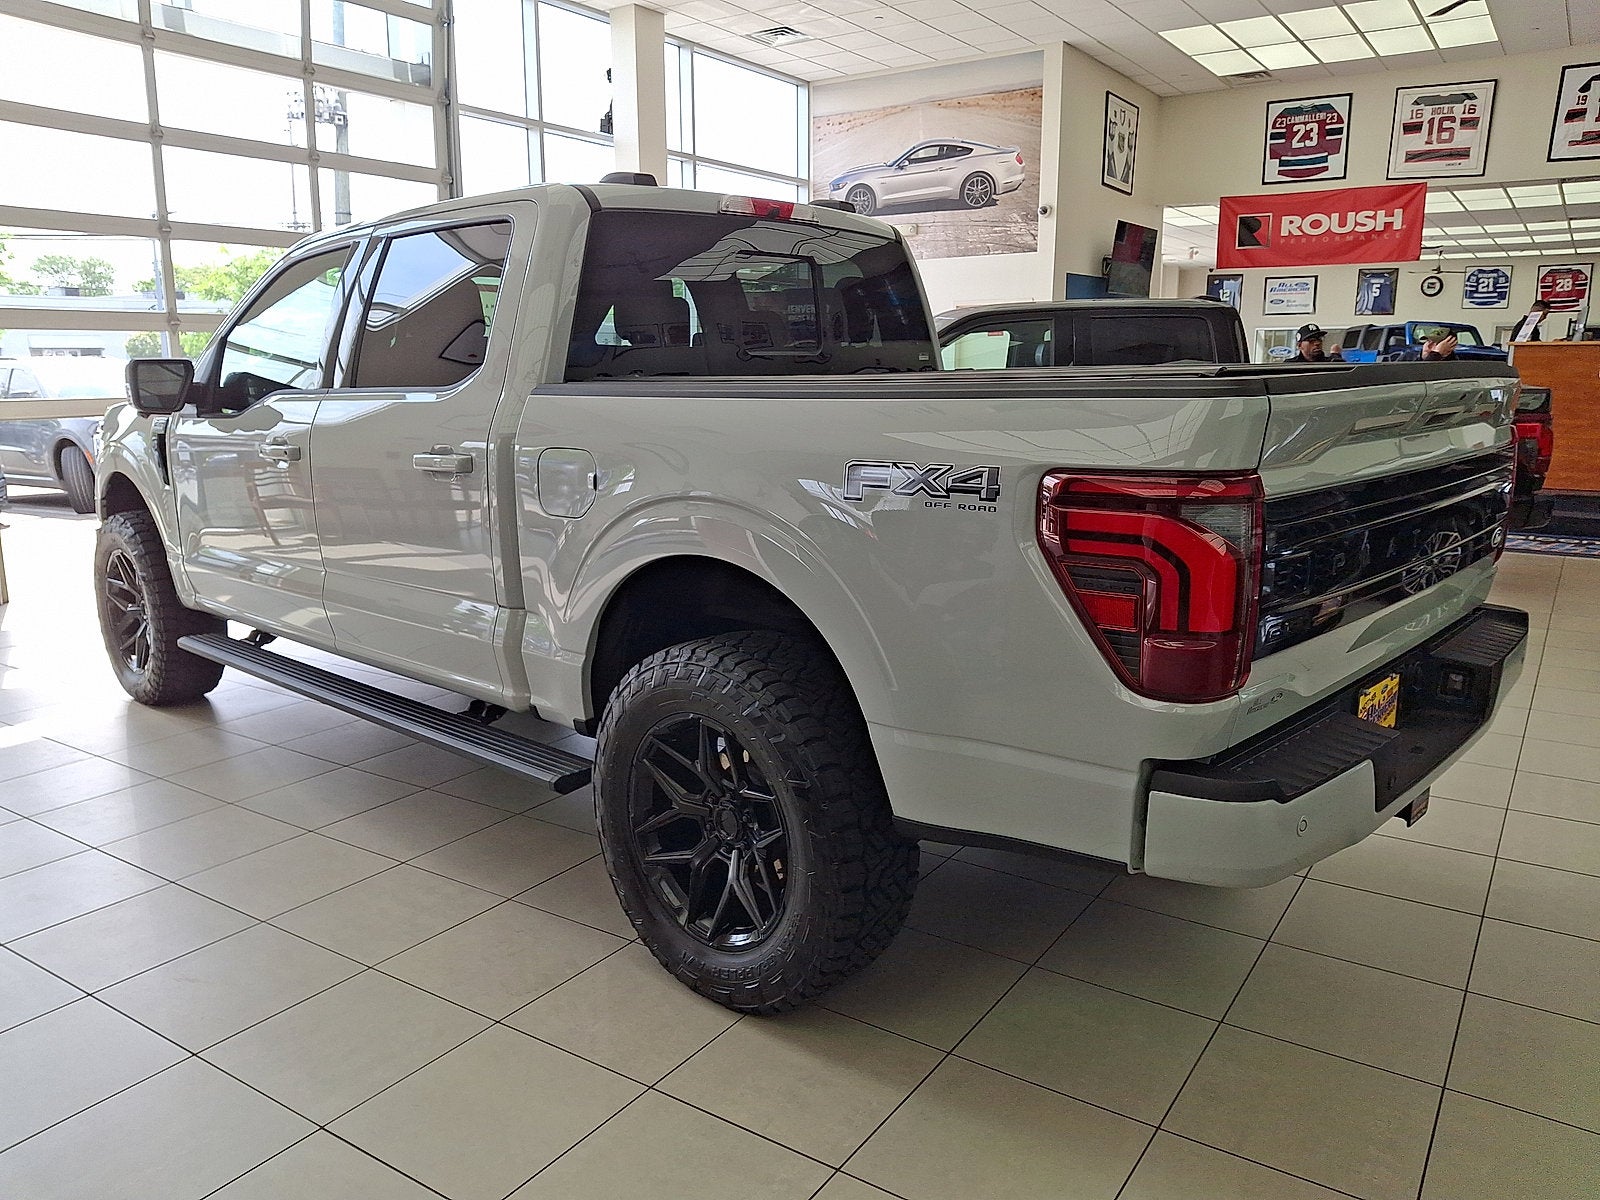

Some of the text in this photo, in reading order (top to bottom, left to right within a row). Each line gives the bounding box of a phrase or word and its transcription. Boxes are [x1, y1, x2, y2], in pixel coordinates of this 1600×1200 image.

[1576, 95, 1588, 105] 19
[1409, 108, 1424, 119] 16
[1431, 105, 1455, 116] HOLIK
[1462, 103, 1477, 114] 16
[1275, 118, 1286, 127] 23
[1326, 112, 1338, 123] 23
[1291, 122, 1319, 149] 23
[1424, 115, 1457, 145] 16
[1280, 208, 1403, 237] ROUSH
[1280, 233, 1402, 245] PERFORMANCE
[1372, 283, 1381, 297] 5
[1478, 278, 1495, 292] 21
[1556, 278, 1573, 292] 28
[1219, 289, 1231, 301] 12
[843, 459, 1001, 502] FX4
[924, 501, 997, 513] OFF ROAD
